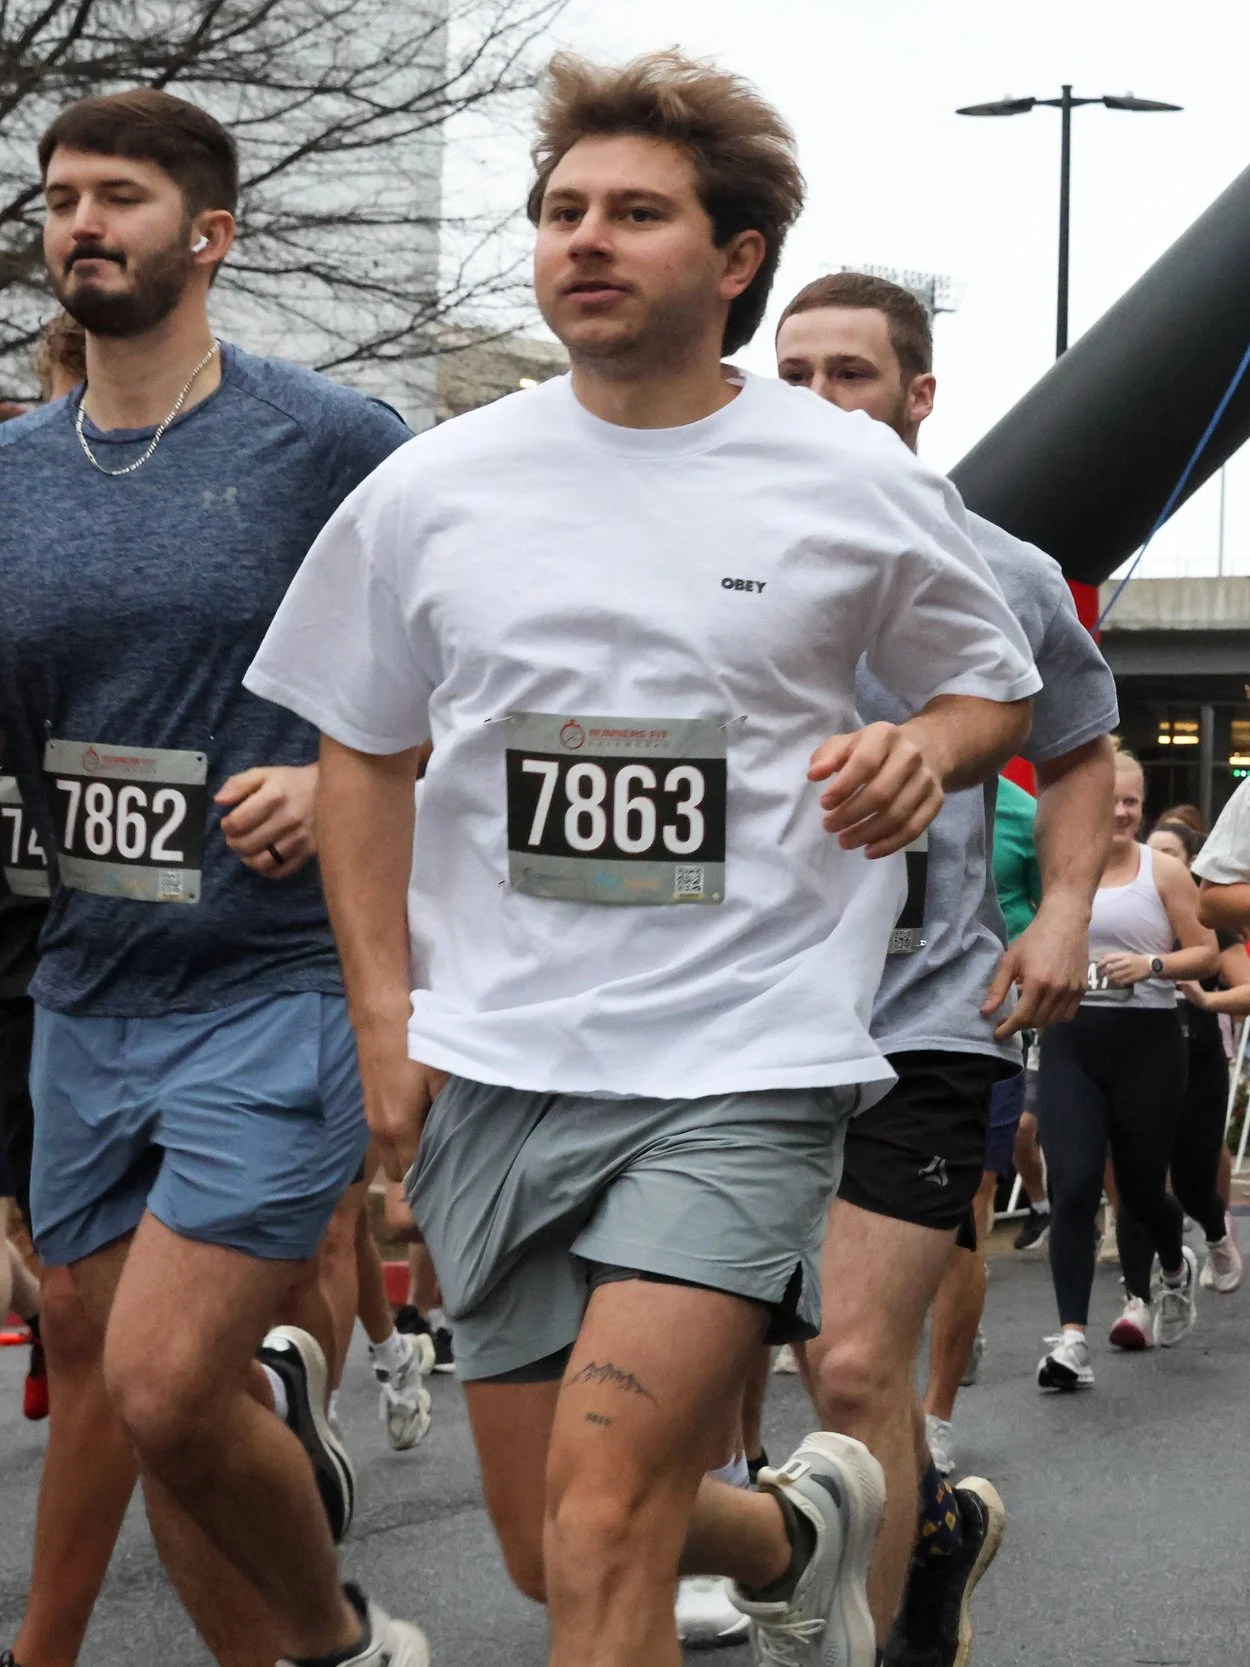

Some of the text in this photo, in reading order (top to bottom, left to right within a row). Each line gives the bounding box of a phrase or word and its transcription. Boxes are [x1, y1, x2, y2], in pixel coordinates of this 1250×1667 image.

[721, 577, 767, 594] OBEY
[55, 779, 188, 863] 7862
[521, 758, 706, 855] 7863
